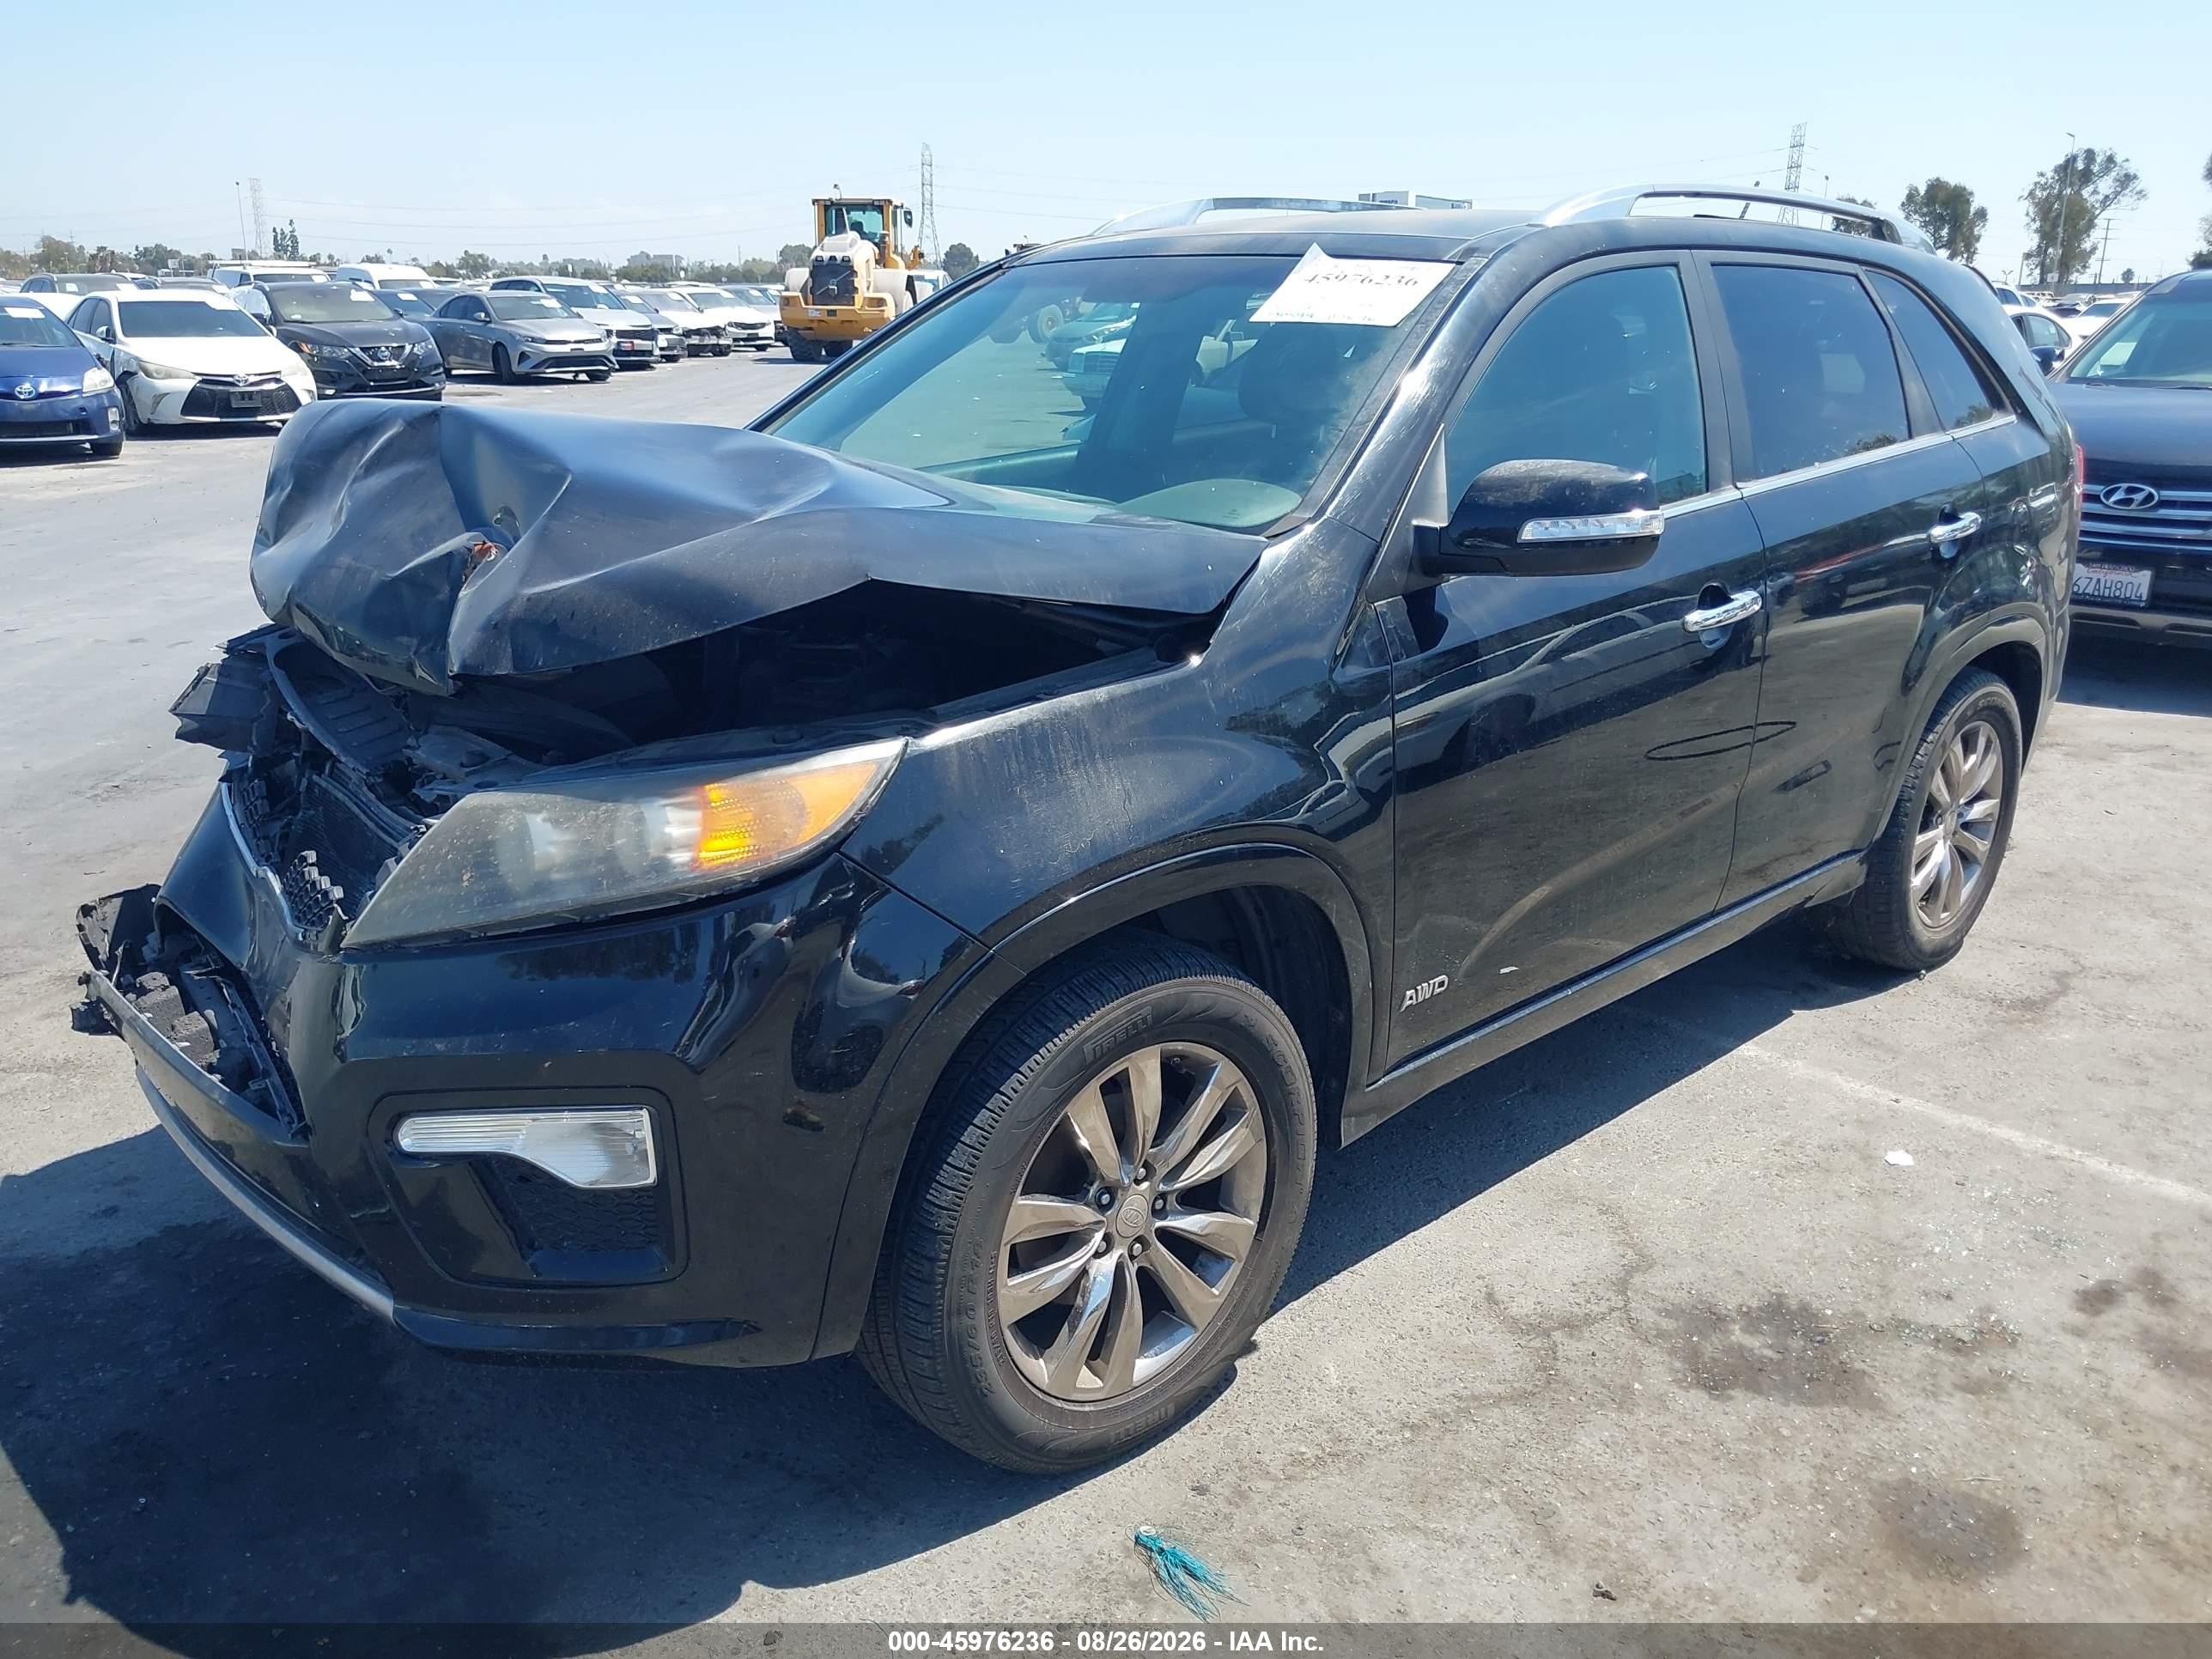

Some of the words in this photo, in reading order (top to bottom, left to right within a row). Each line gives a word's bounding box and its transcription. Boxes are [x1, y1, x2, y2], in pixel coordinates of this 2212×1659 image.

[1303, 270, 1419, 288] 45976236
[2072, 577, 2143, 599] 6ZAH804
[1400, 975, 1449, 1012] AWD
[1083, 1006, 1152, 1066] PIRELLI
